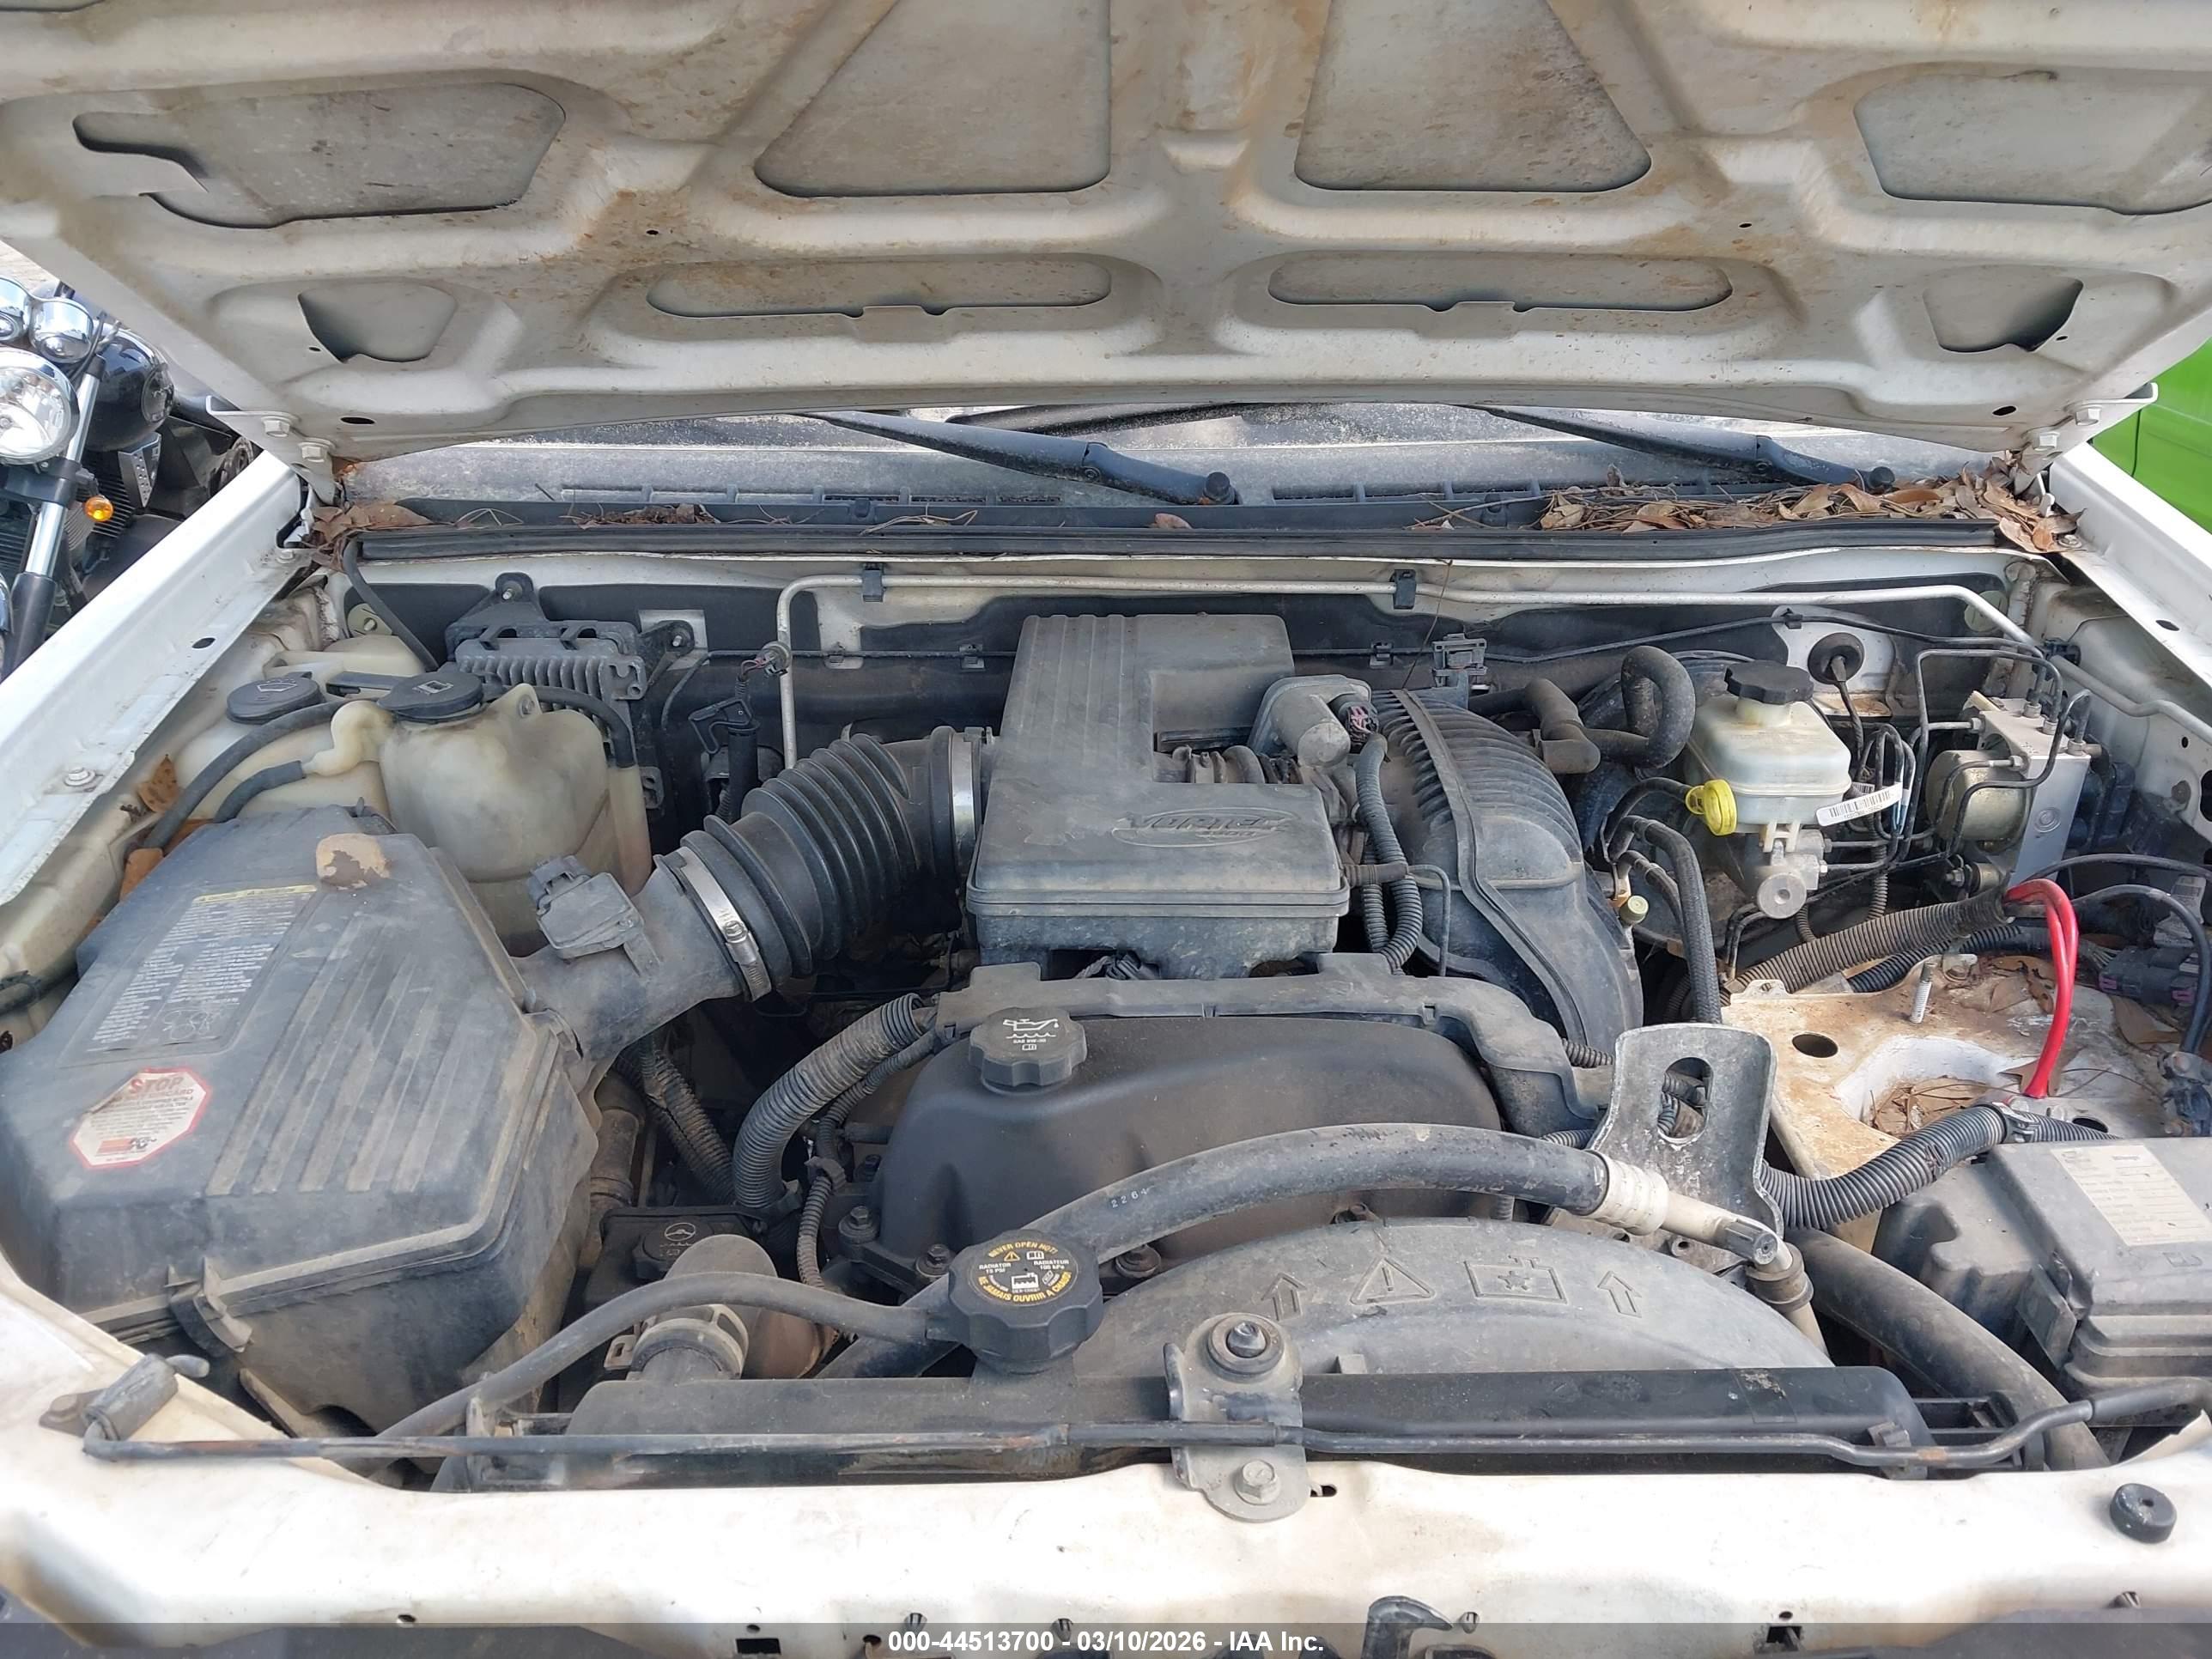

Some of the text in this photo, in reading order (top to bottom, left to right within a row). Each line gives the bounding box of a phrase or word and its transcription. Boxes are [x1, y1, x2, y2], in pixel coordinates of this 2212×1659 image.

[129, 1078, 183, 1093] STOP
[988, 1243, 1013, 1257] NEVER
[1015, 1241, 1038, 1249] OPEN
[979, 1261, 1012, 1270] RADIATOR
[982, 1285, 1012, 1301] JAMAIS
[1012, 1291, 1046, 1303] OUVRIR
